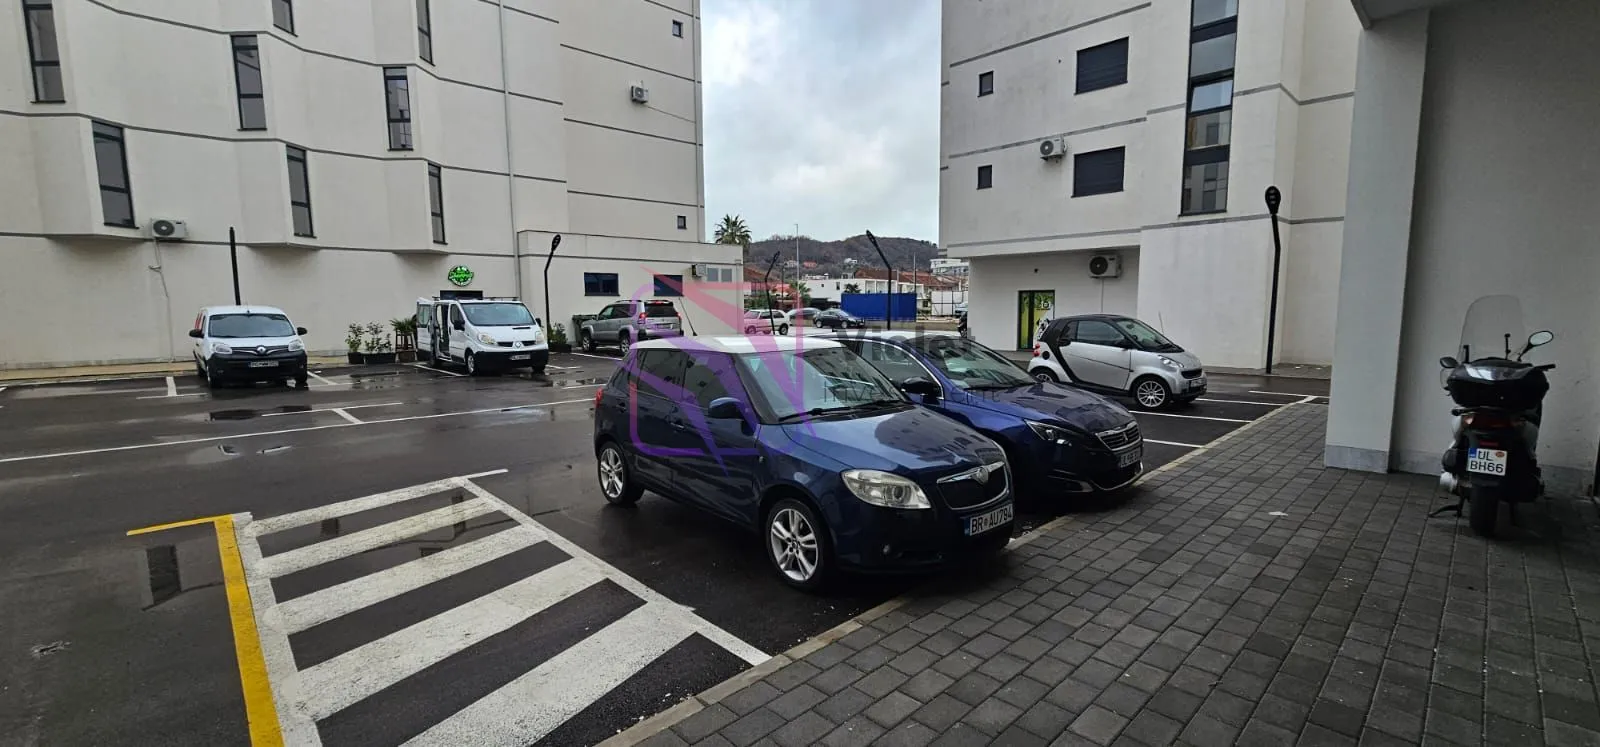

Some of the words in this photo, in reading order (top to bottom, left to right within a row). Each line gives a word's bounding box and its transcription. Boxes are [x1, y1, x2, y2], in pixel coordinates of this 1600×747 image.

[1478, 450, 1493, 461] UL
[1470, 460, 1504, 473] BH66
[971, 517, 983, 533] BR
